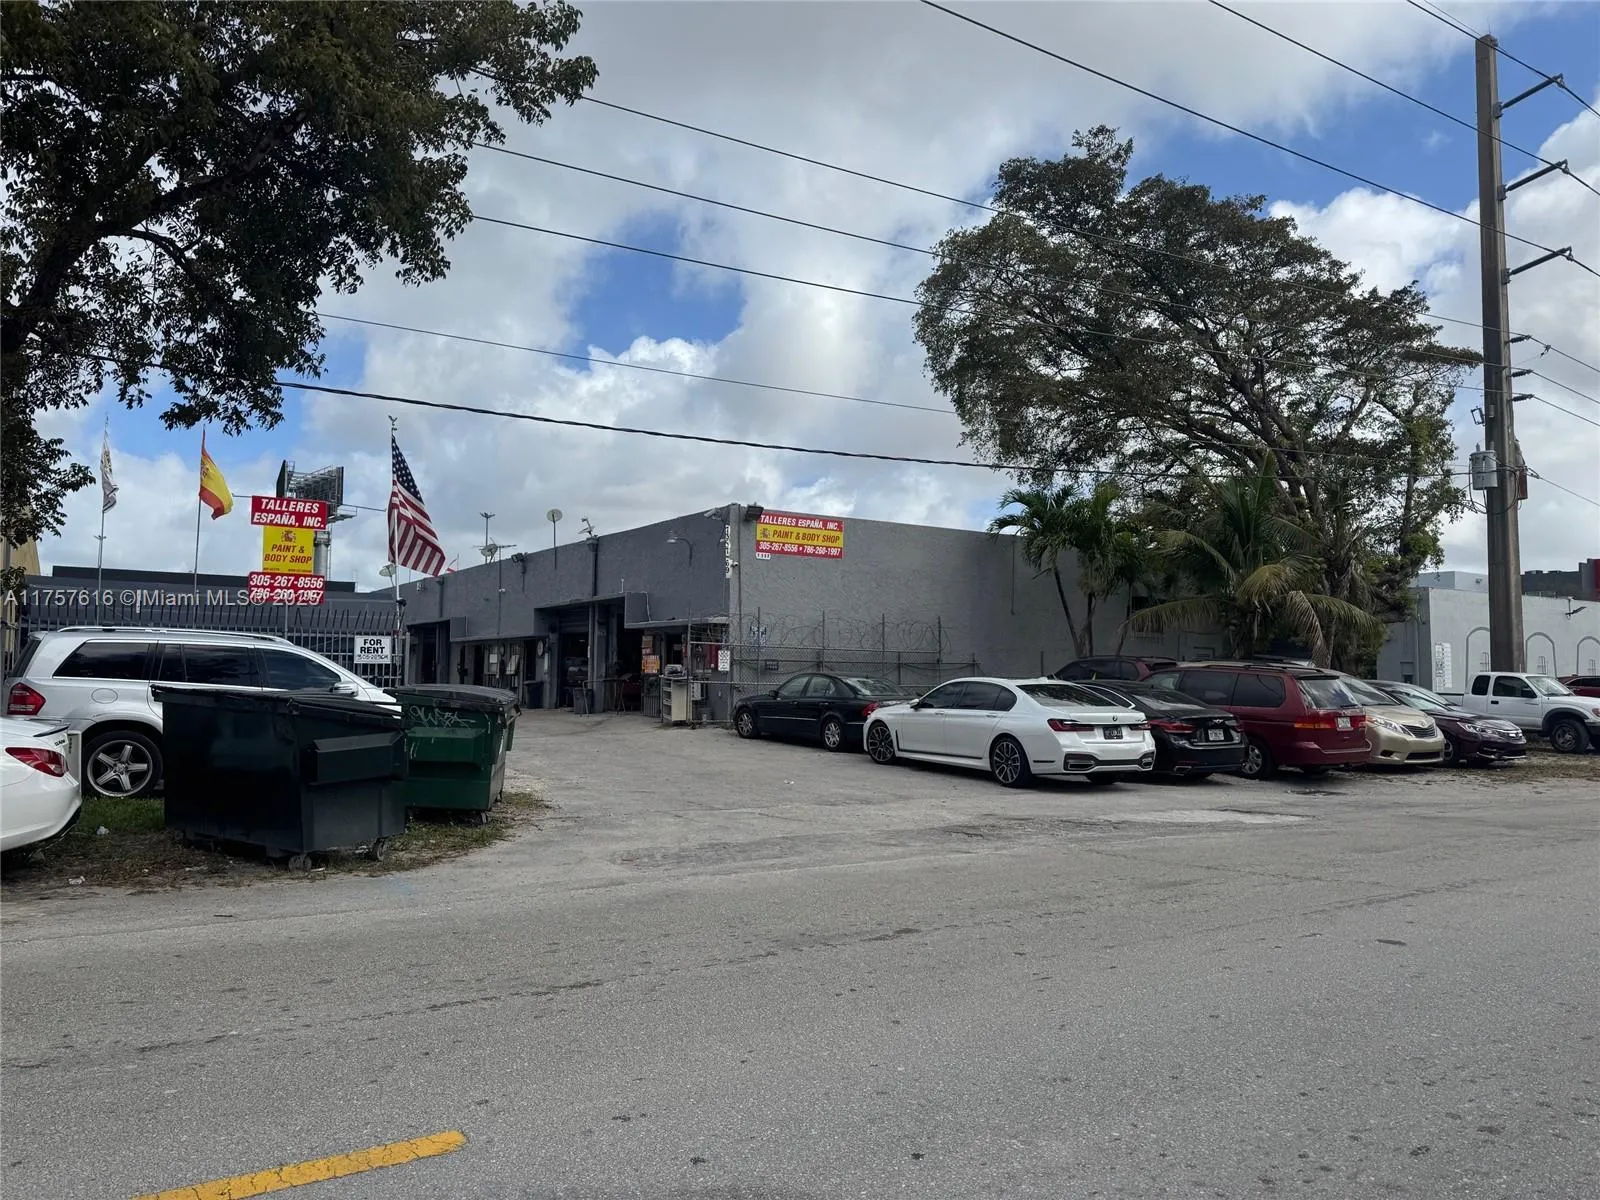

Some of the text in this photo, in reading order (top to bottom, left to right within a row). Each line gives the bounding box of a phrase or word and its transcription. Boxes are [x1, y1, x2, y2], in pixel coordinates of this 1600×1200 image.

[260, 498, 320, 514] TALLERES
[253, 512, 325, 528] ESPAÑA, INC.
[760, 514, 840, 531] TALLERES ESPAÑA, INC.
[772, 529, 840, 544] PAINT & BODY SHOP
[271, 543, 305, 554] PAINT &
[759, 541, 799, 553] 305-267-8556
[264, 553, 313, 564] BODY SHOP
[249, 574, 324, 588] 305-267-8556
[363, 638, 383, 646] FOR
[360, 646, 386, 654] RENT
